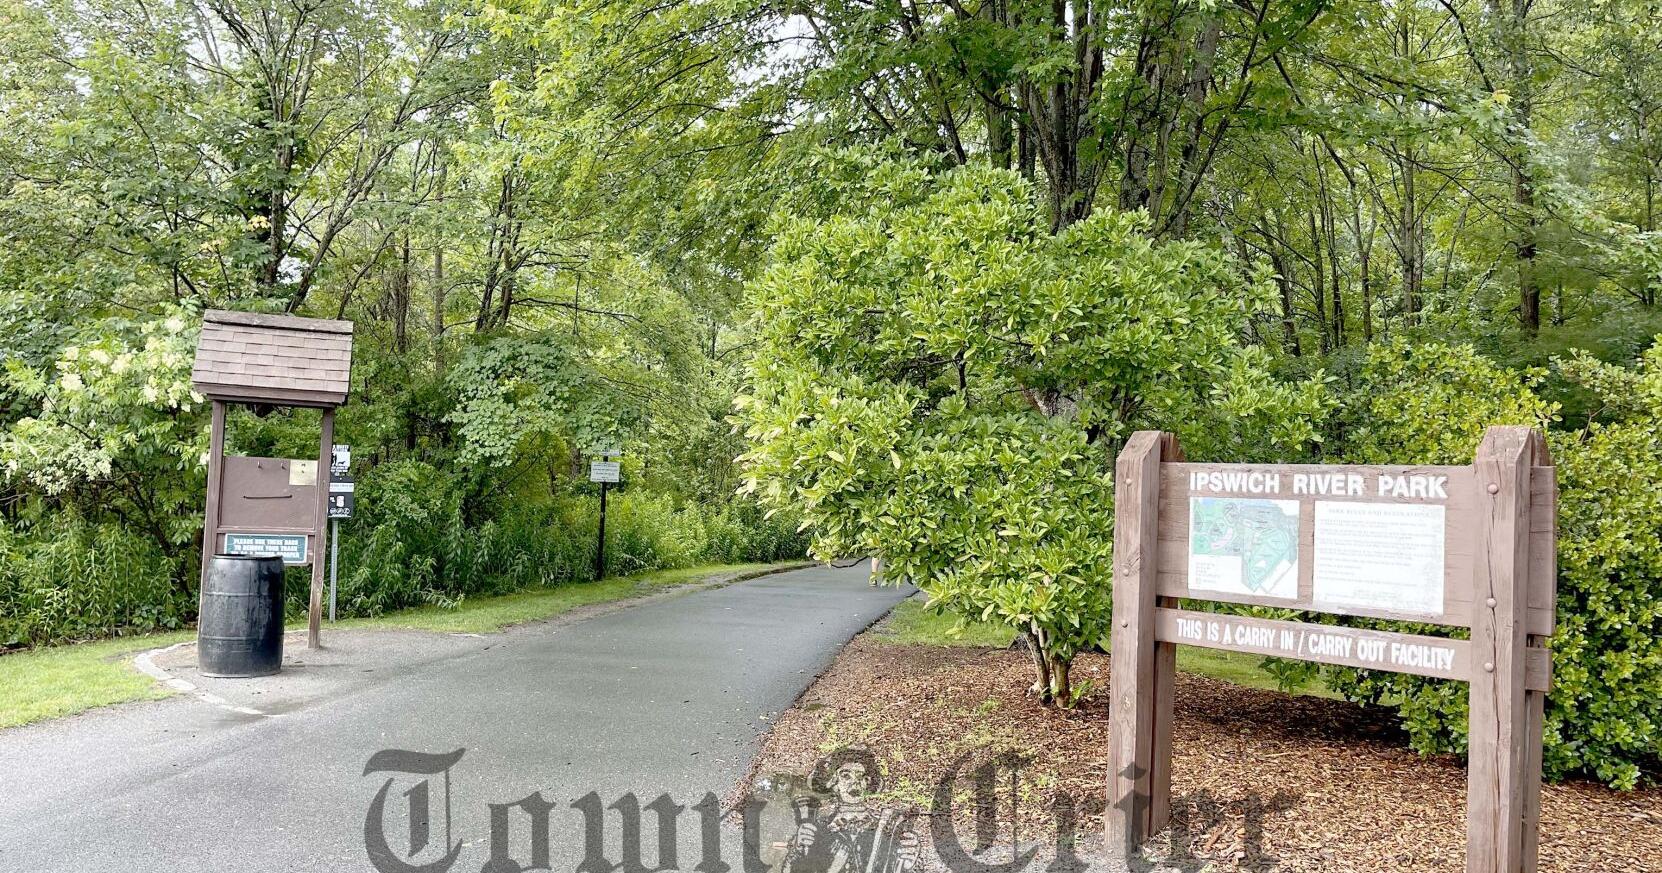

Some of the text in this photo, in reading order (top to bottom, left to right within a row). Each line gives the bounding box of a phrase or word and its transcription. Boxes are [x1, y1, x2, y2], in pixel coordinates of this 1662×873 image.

[1189, 471, 1449, 500] IPSWICH RIVER PARK
[1176, 618, 1202, 640] THIS
[1207, 622, 1219, 642] IS
[1223, 624, 1233, 645] A
[1234, 625, 1276, 648] CARRY
[1280, 630, 1294, 651] IN
[1308, 633, 1352, 658] CARRY
[1357, 638, 1388, 662] OUT
[1391, 643, 1455, 671] FACILITY
